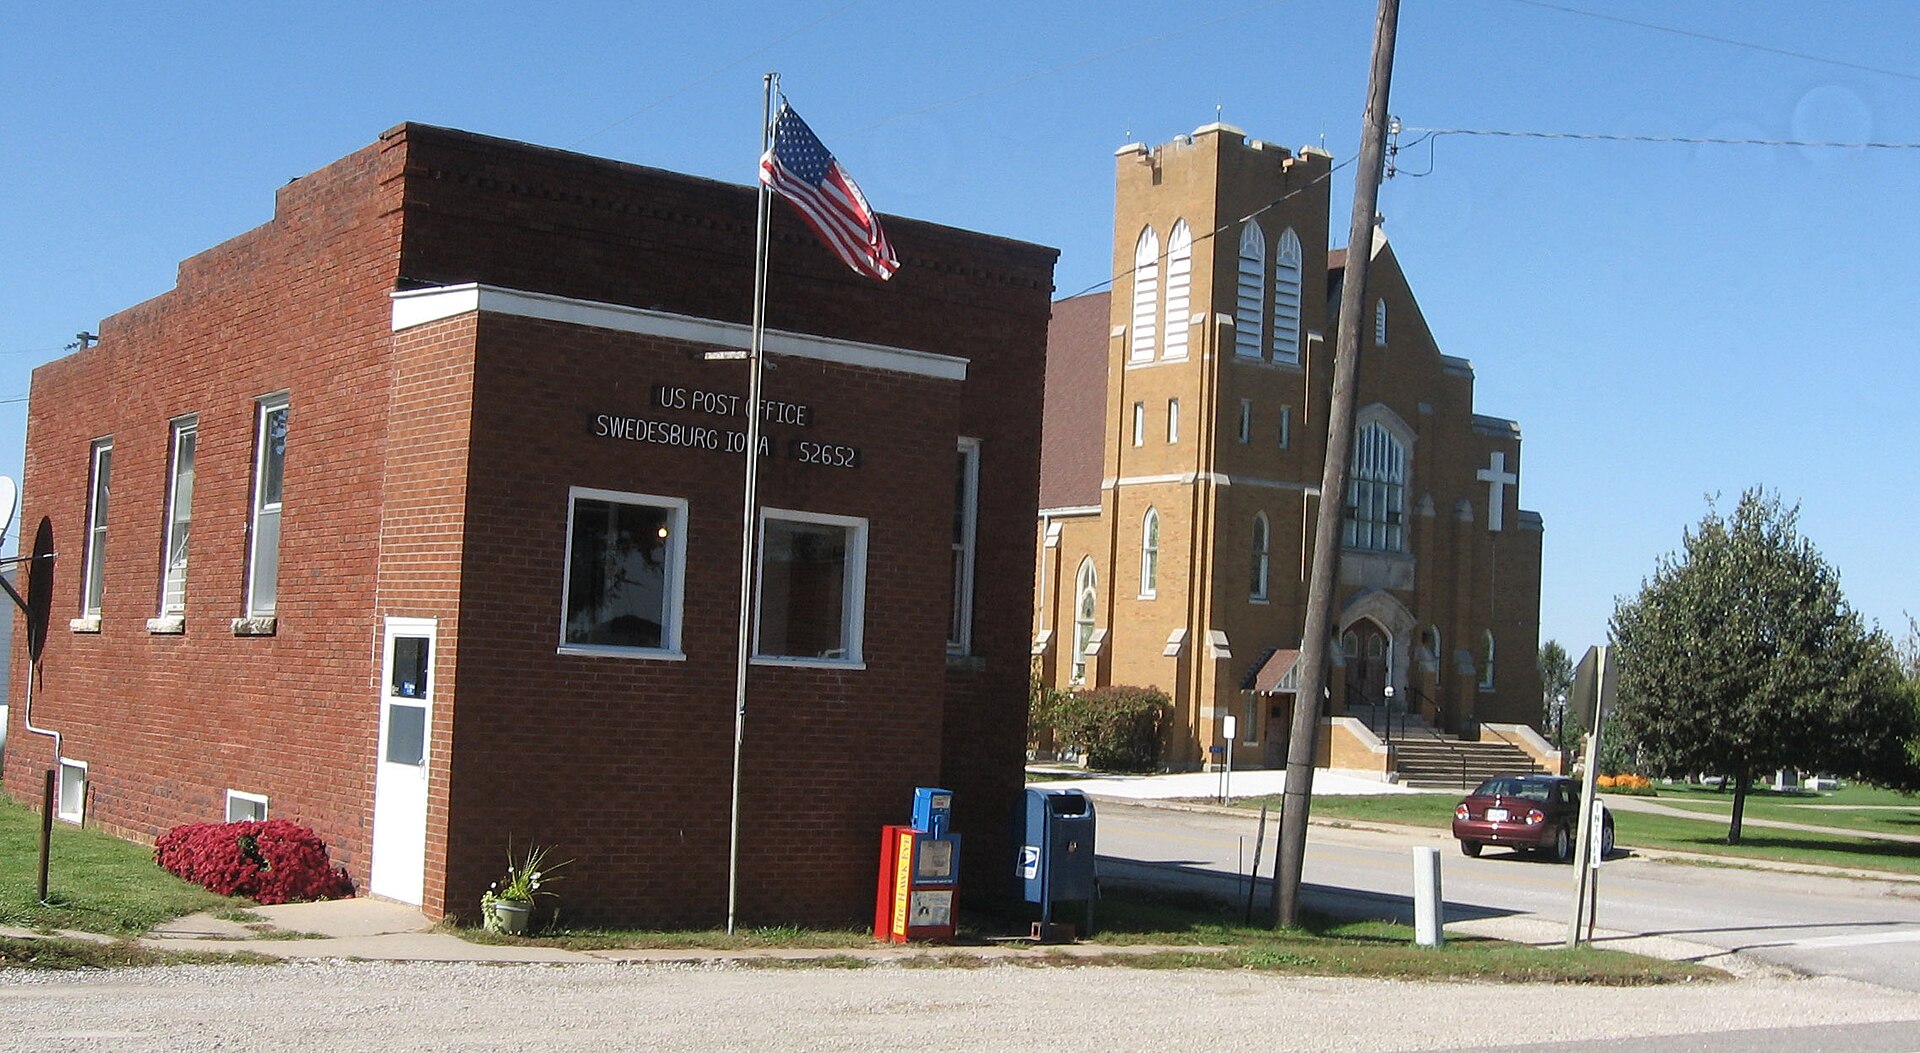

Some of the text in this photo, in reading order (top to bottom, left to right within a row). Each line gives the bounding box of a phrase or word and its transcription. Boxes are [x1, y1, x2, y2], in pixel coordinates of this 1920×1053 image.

[661, 386, 687, 409] US
[692, 390, 740, 416] POST
[596, 414, 855, 468] SWEDESBURG IOA 52652
[895, 836, 910, 931] THE HAWK EYE
